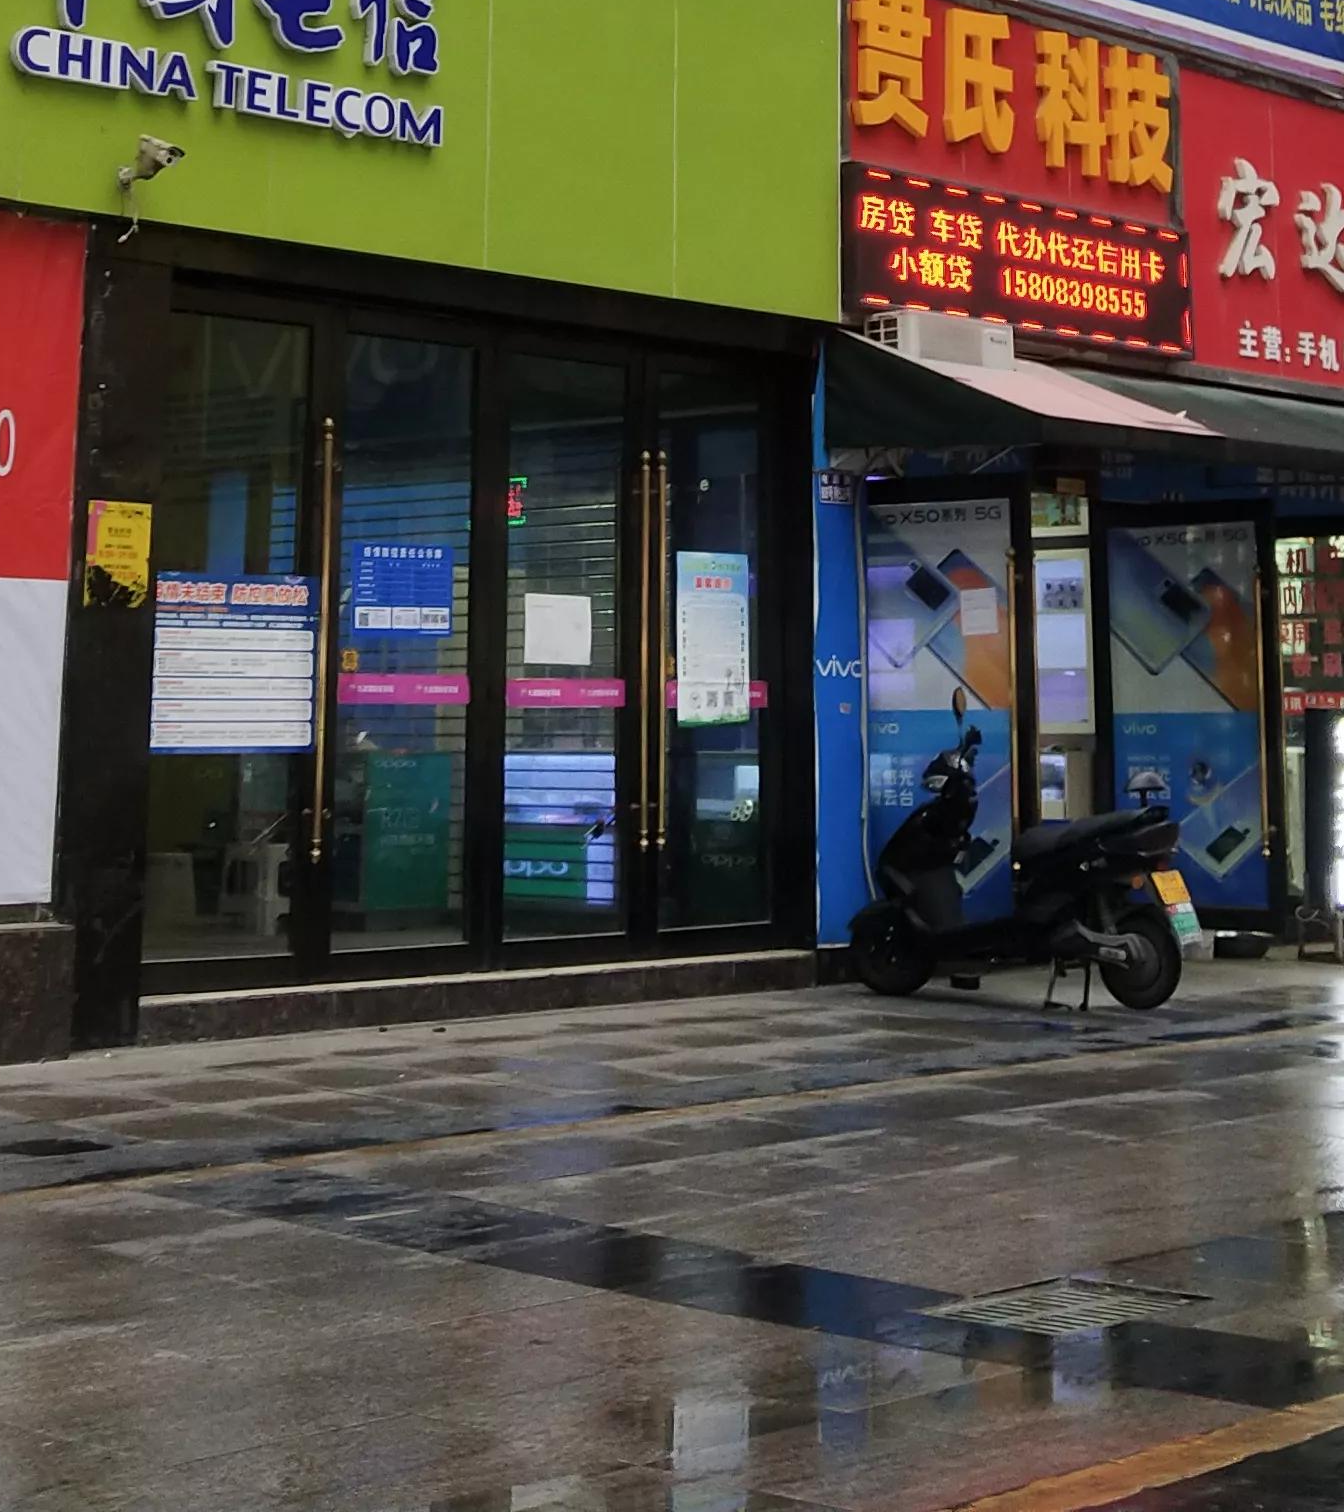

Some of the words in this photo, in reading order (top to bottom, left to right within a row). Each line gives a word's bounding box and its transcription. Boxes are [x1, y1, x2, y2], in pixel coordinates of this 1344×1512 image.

[9, 25, 198, 102] CHINA
[205, 59, 445, 148] TELECOM
[858, 194, 916, 239] 房贷
[929, 207, 984, 251] 车贷
[996, 220, 1166, 285] 代办代还信用卡
[889, 246, 973, 294] 小额贷
[1001, 265, 1148, 320] 15808398555
